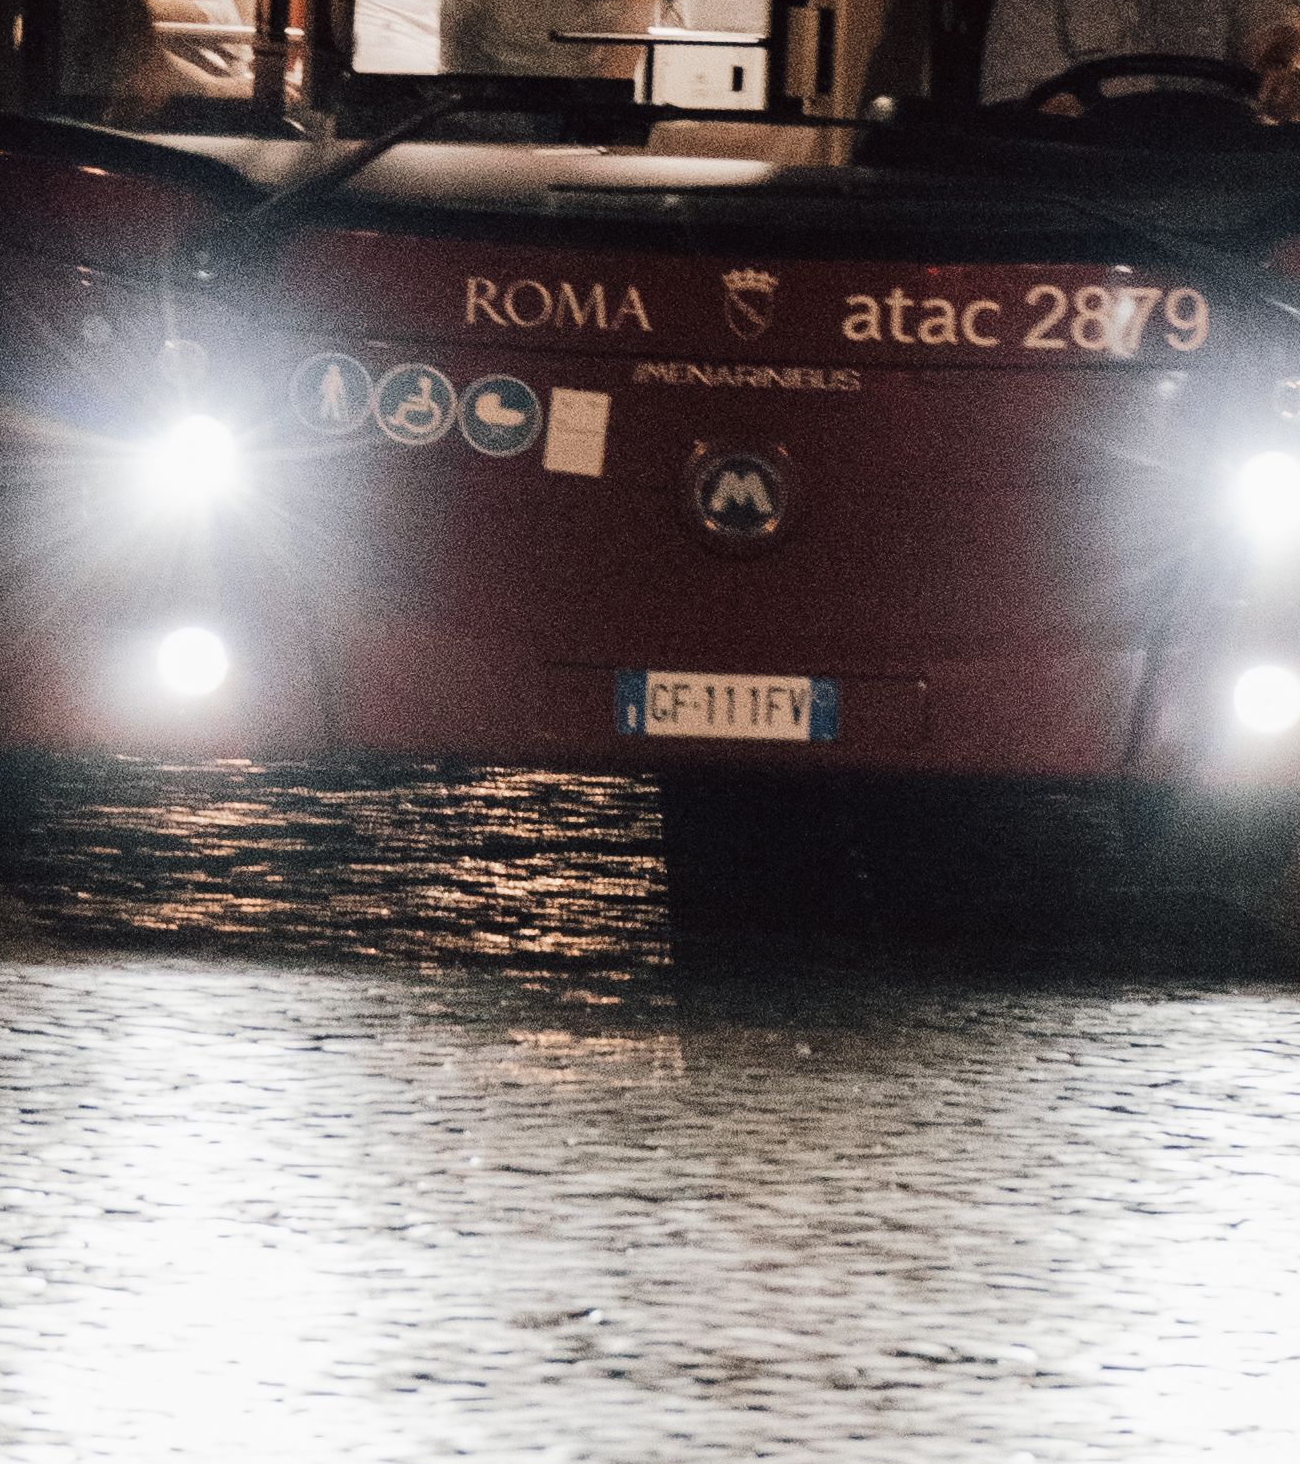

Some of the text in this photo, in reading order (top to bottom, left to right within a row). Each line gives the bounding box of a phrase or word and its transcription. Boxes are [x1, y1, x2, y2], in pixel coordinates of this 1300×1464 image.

[464, 275, 654, 332] ROMA
[841, 283, 1210, 354] atac 2879
